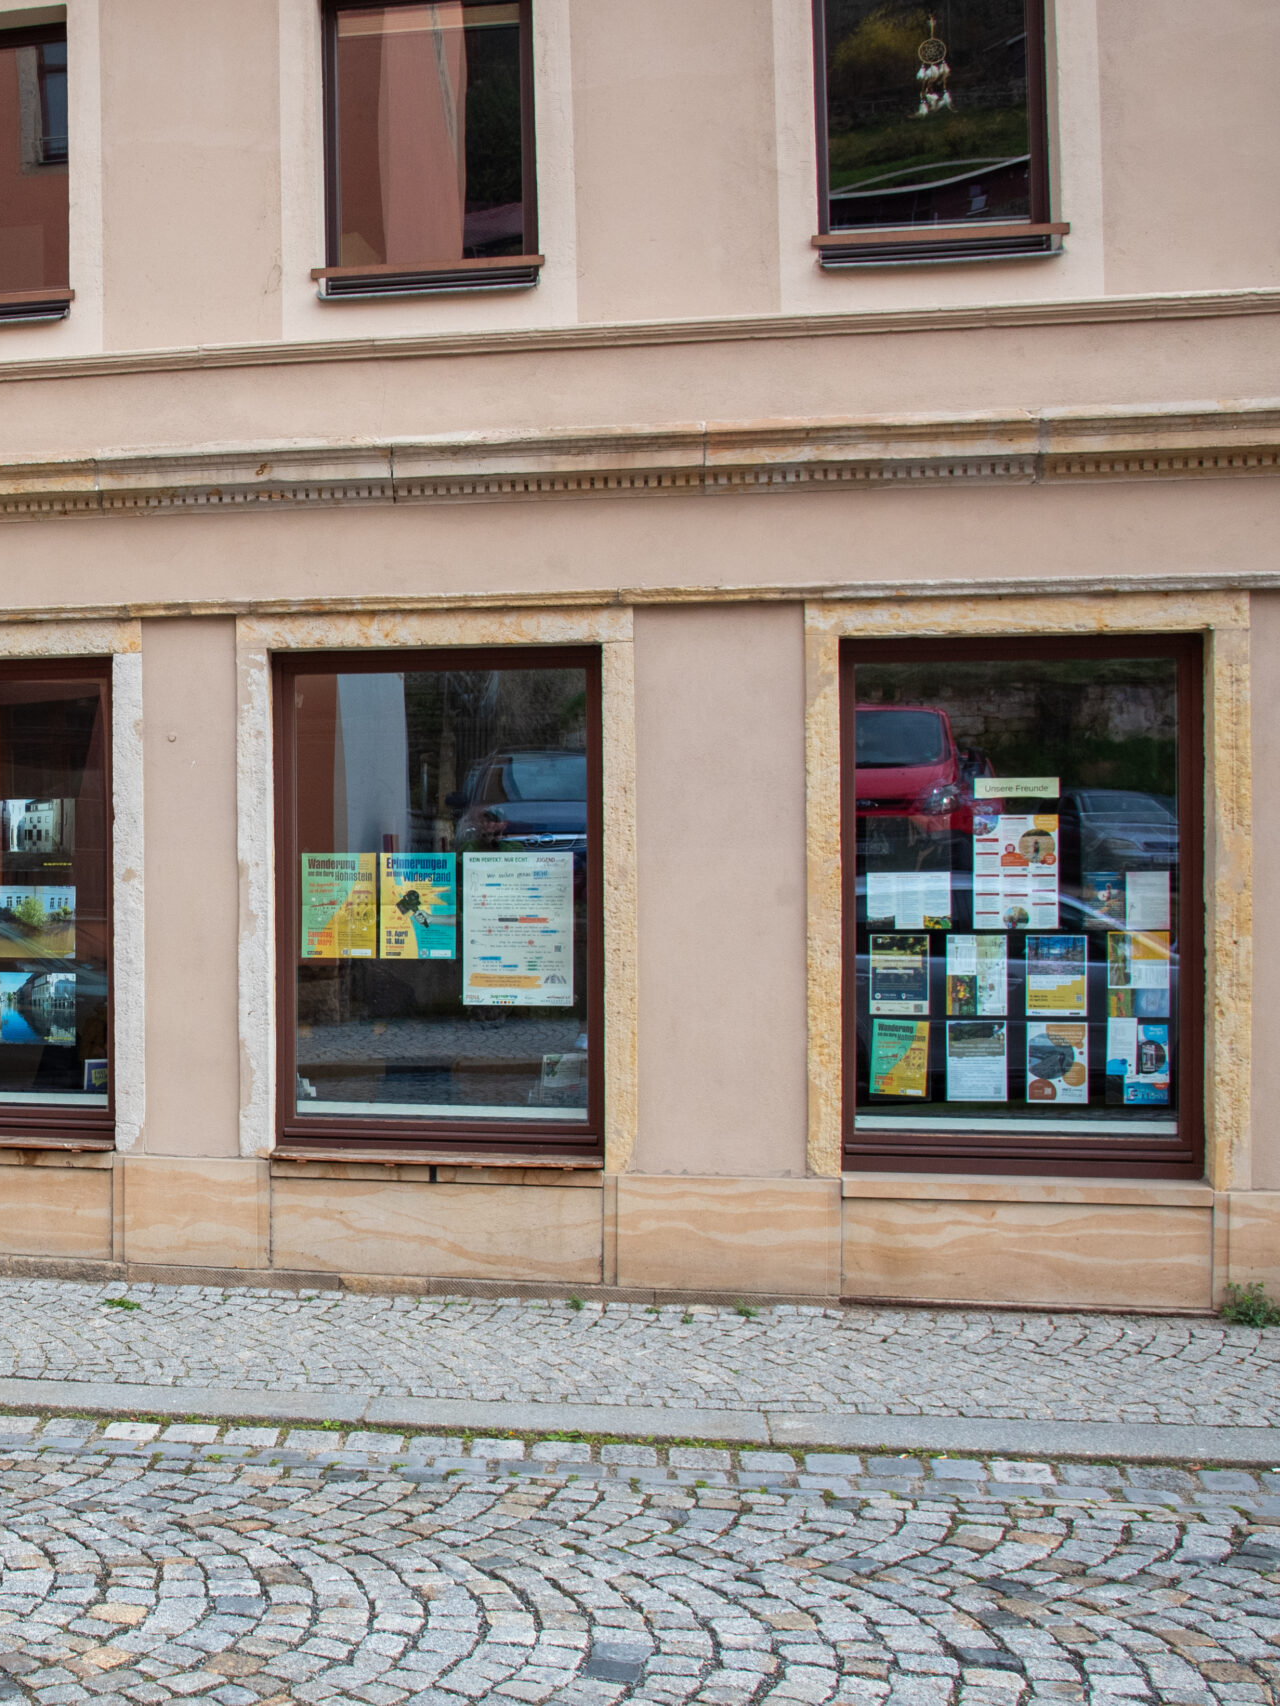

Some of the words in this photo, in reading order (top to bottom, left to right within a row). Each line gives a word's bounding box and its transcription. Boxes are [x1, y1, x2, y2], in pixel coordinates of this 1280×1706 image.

[984, 785, 1013, 793] Unsere
[1015, 784, 1049, 792] Freunde
[307, 858, 356, 871] Wanderung
[386, 857, 448, 870] Erinnerungen
[334, 871, 373, 882] Hohnstein
[403, 871, 451, 882] Widerstand
